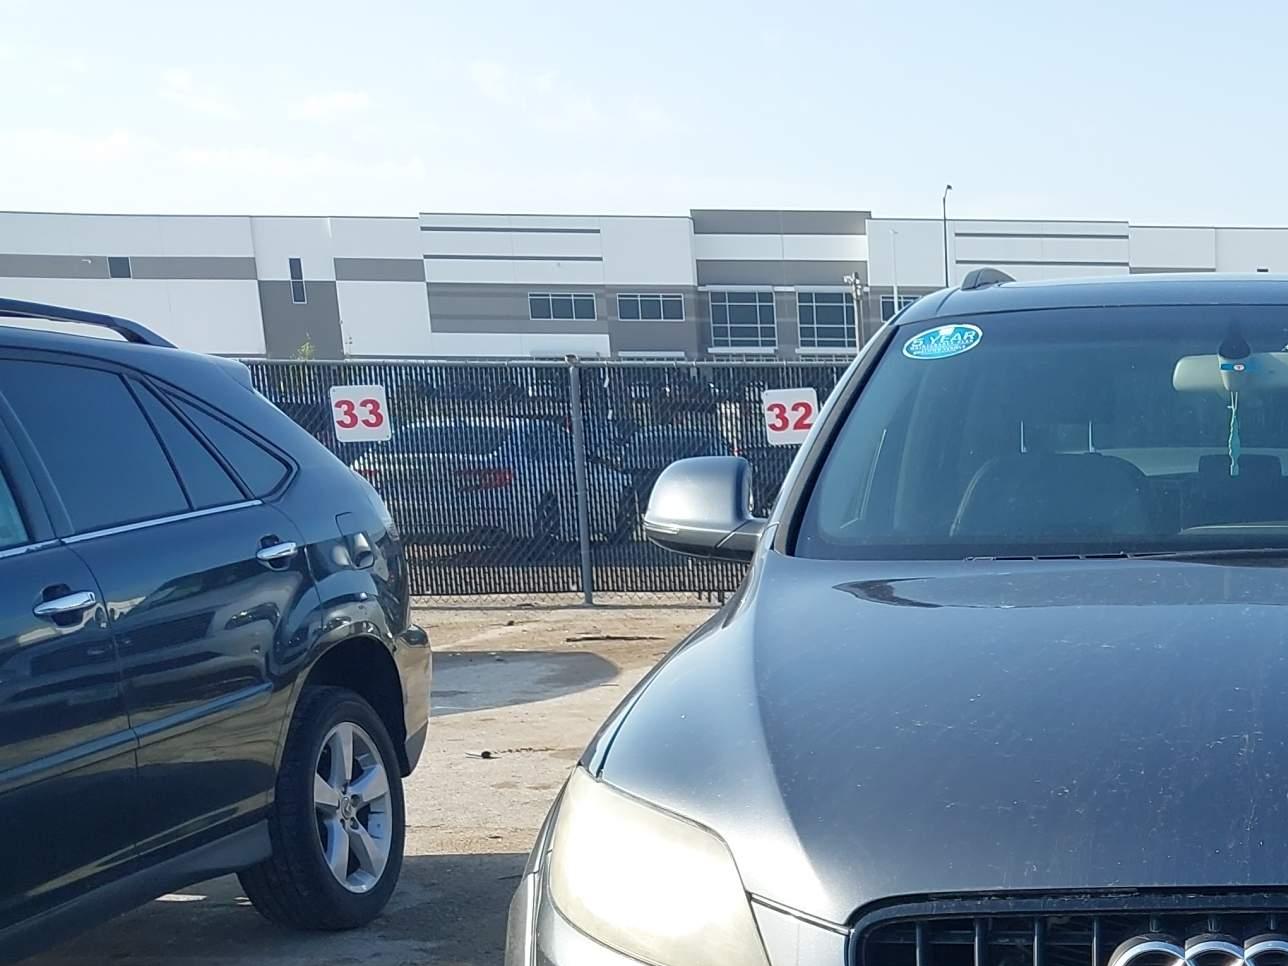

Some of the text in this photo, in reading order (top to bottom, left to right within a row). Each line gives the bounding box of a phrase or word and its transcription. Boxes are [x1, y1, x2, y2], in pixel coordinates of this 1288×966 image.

[929, 330, 977, 346] YEAR
[334, 398, 384, 429] 33
[767, 401, 814, 432] 32
